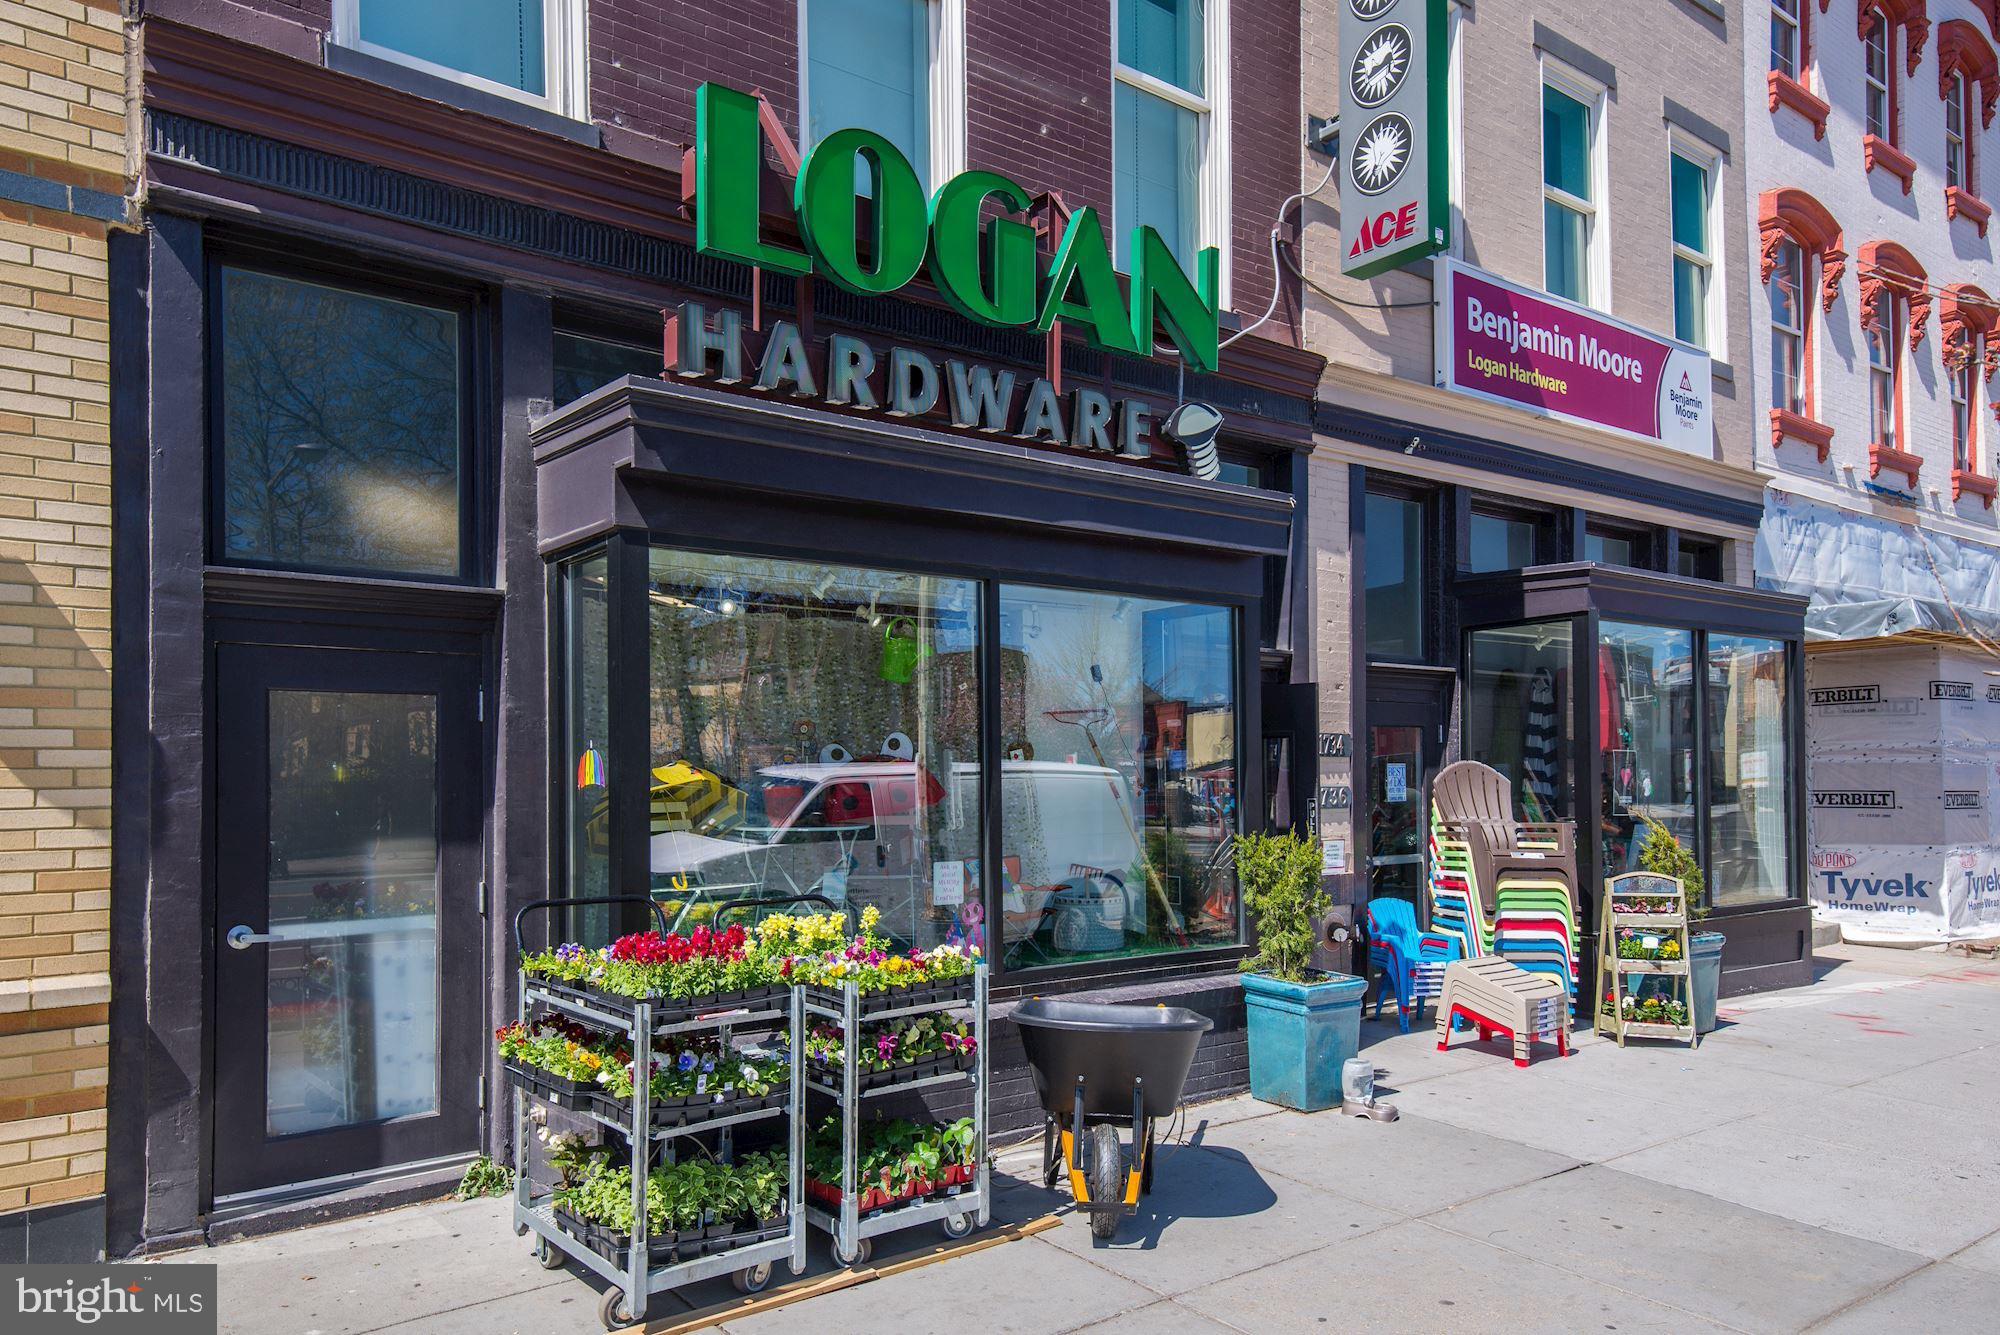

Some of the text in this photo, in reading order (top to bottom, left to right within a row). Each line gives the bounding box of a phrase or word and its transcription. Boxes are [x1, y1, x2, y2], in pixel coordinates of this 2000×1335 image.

[696, 81, 1219, 373] LOGAN
[1349, 201, 1418, 259] ACE
[1467, 296, 1643, 384] Benjamin Moore
[676, 300, 1153, 459] HARDWARE
[1468, 349, 1568, 395] Logan Hardware
[1670, 389, 1703, 410] Benjamin
[1675, 404, 1698, 421] Moore
[1680, 418, 1694, 430] Paints
[1319, 734, 1344, 755] 1734
[1320, 787, 1347, 806] 736
[1812, 793, 1891, 806] VERBILT
[1820, 871, 1929, 900] Tyvek
[1828, 900, 1917, 915] HomeWrap
